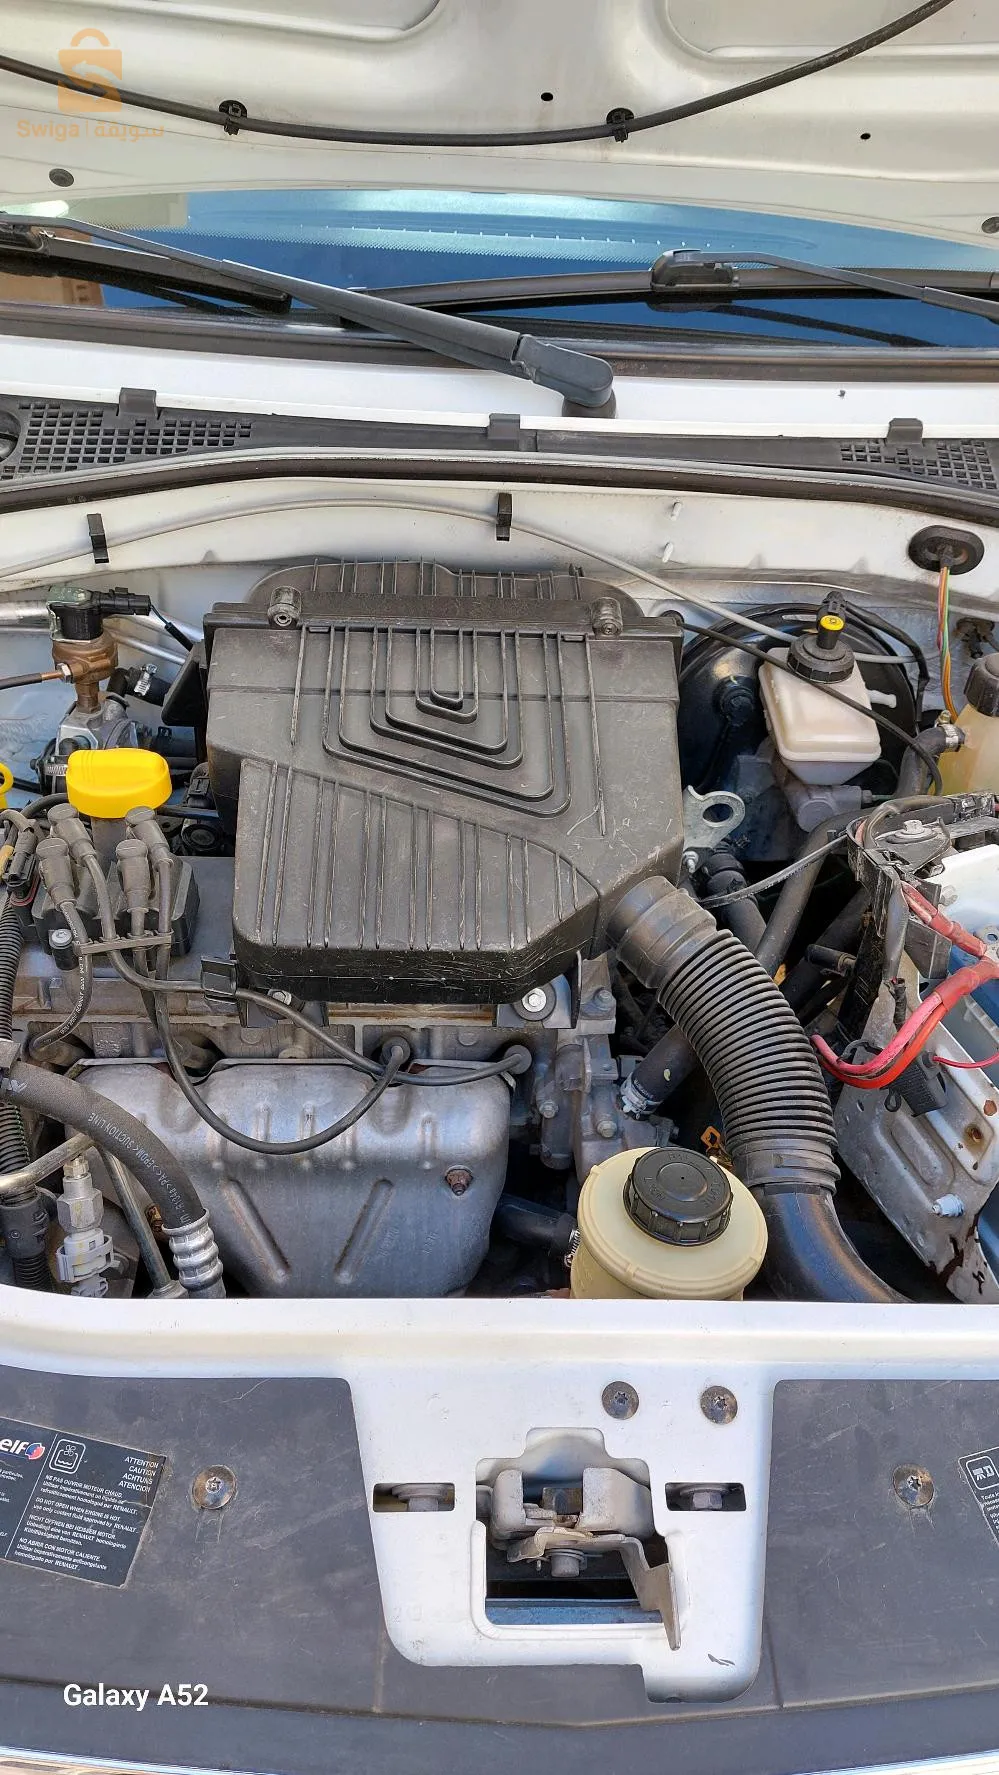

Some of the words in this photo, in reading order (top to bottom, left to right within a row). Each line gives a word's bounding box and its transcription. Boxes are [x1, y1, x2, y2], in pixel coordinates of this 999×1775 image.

[88, 1112, 105, 1129] LINE
[104, 1121, 135, 1149] SUCTION
[0, 1438, 29, 1454] elf
[125, 1456, 159, 1469] ATTENTION
[128, 1465, 157, 1477] CAUTION
